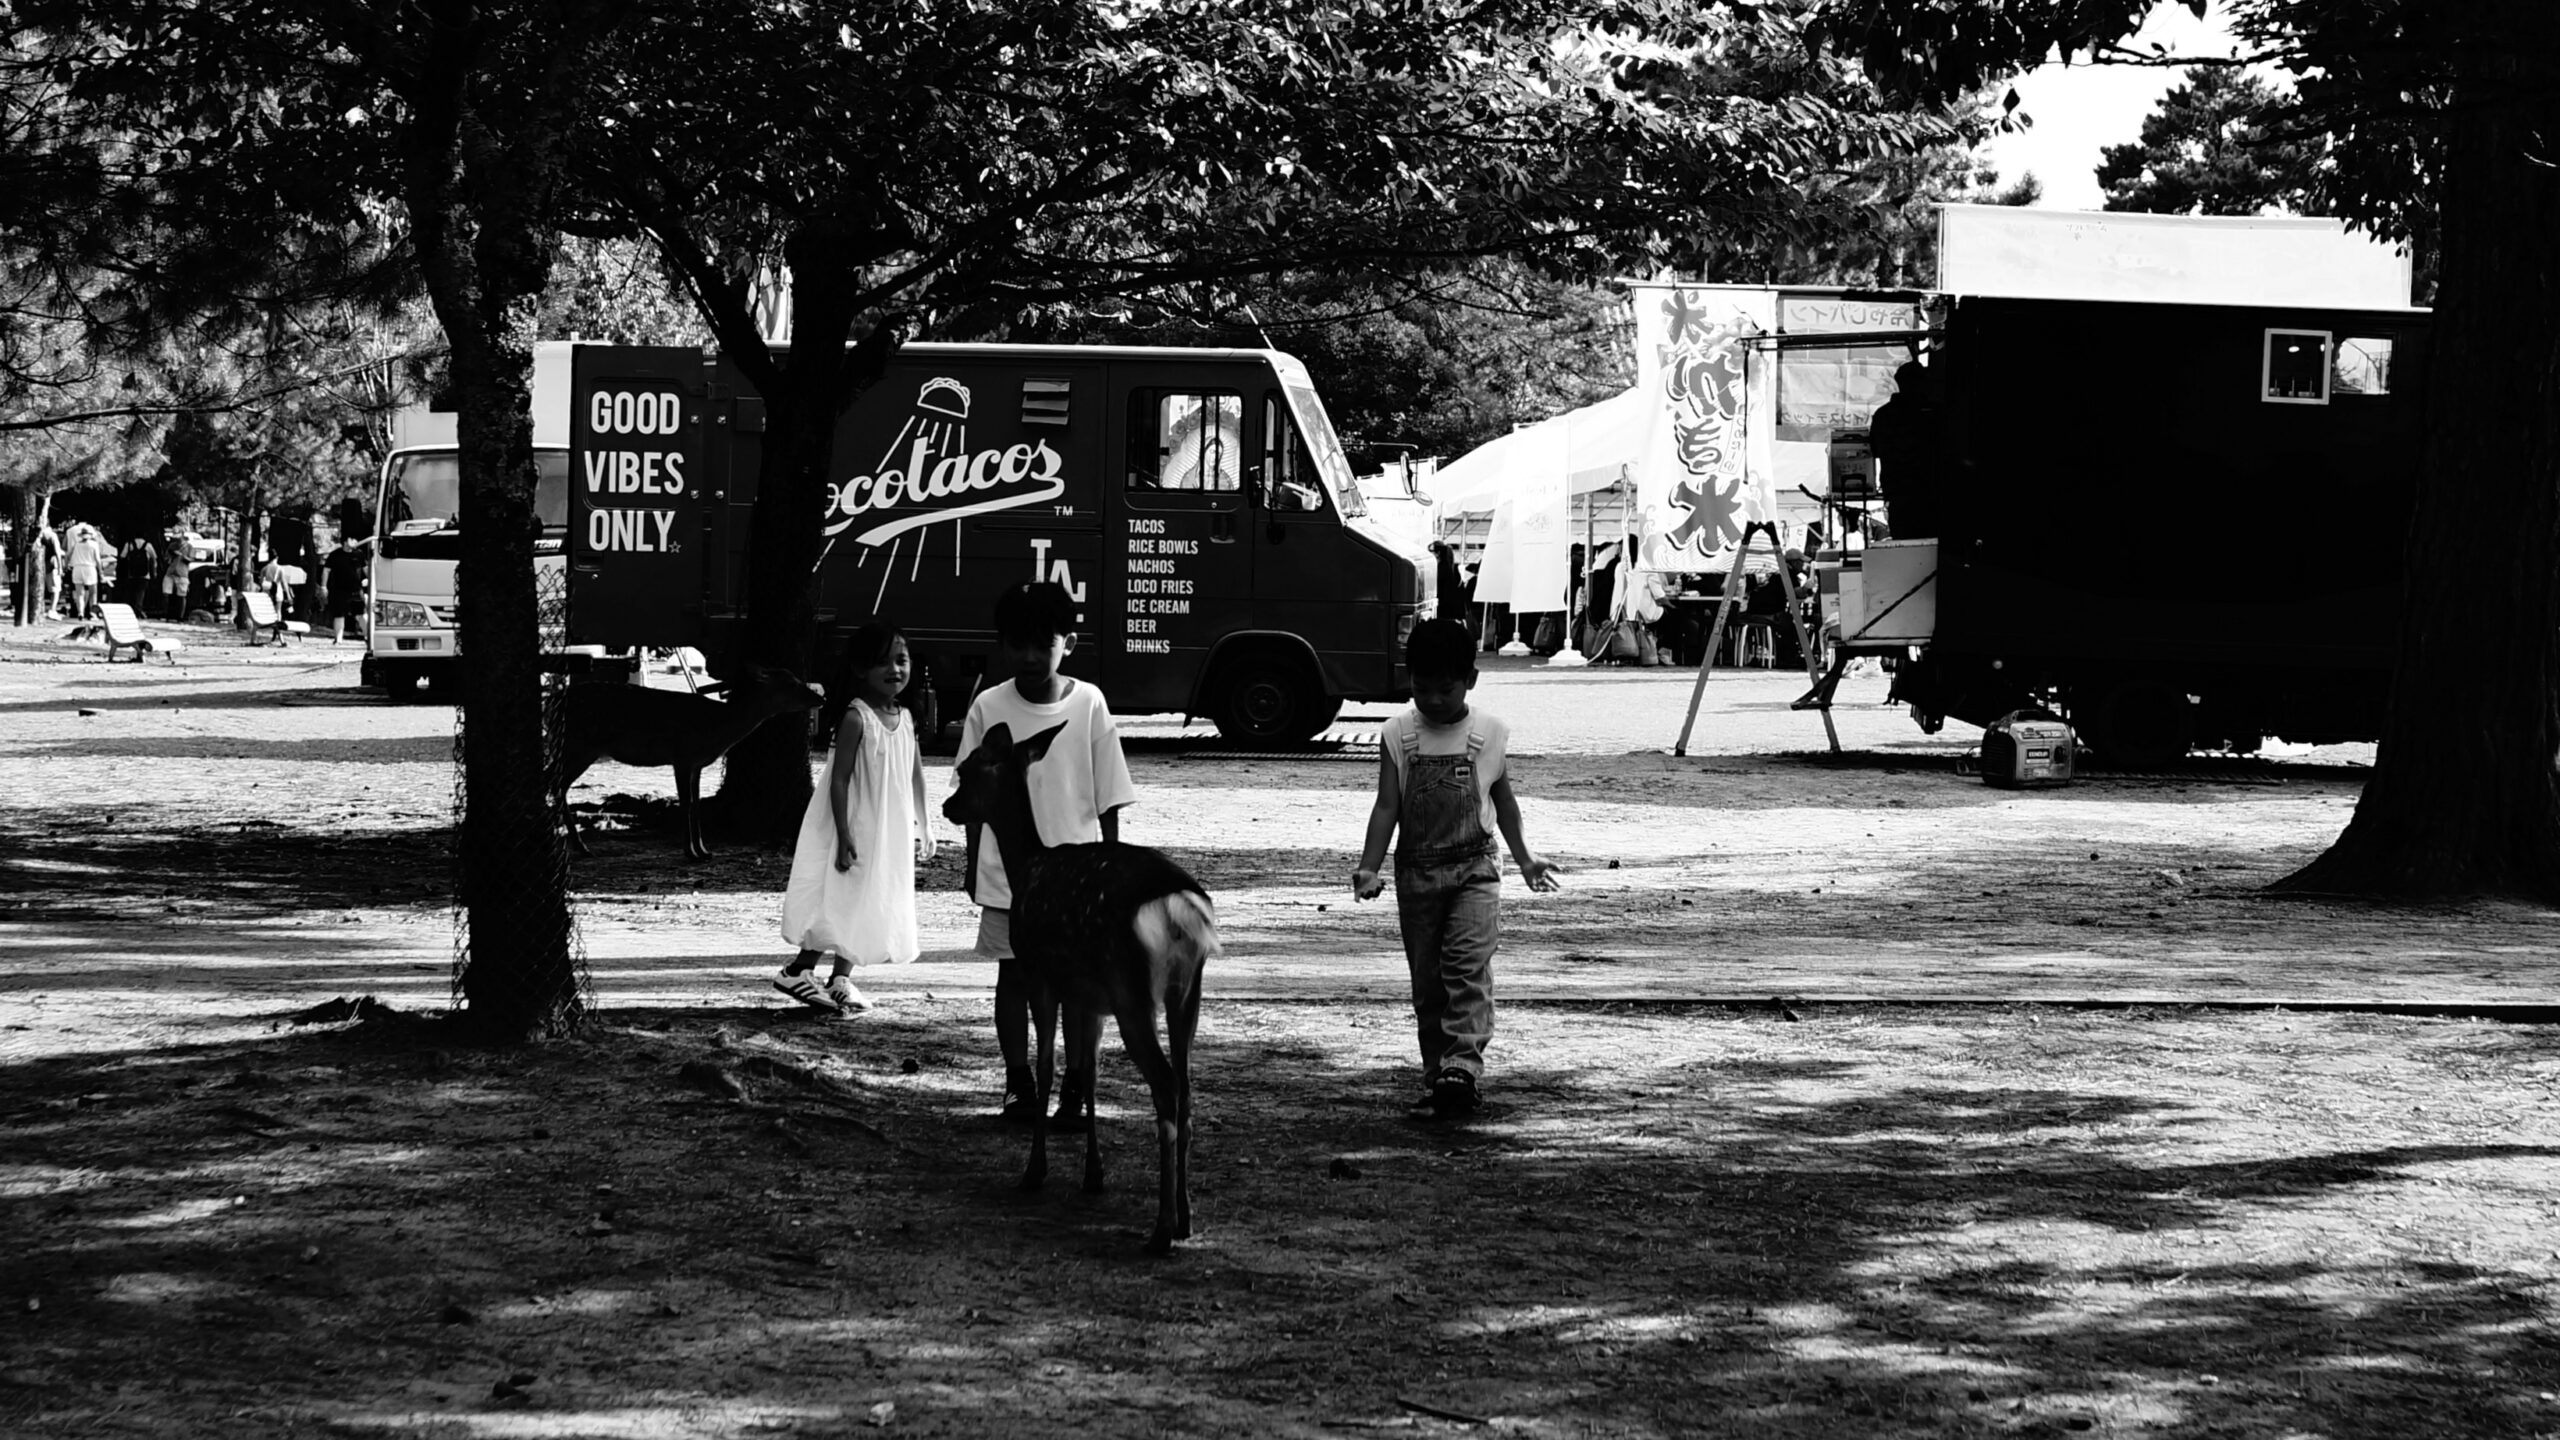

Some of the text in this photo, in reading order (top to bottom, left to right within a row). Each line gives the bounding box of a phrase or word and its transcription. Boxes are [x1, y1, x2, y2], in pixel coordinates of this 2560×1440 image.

[591, 390, 680, 435] GOOD
[583, 450, 684, 495] VIBES
[825, 437, 1065, 520] cotacos
[1054, 505, 1074, 516] TM
[589, 508, 676, 553] ONLY
[1128, 519, 1165, 534] TACOS
[1128, 539, 1199, 555] RICE BOWLS
[1128, 559, 1175, 574] NACHOS
[1127, 579, 1194, 594] LOCO FRIES
[1127, 599, 1190, 614] ICE CREAM
[1126, 619, 1157, 633] BEER
[1126, 639, 1170, 654] DRINKS
